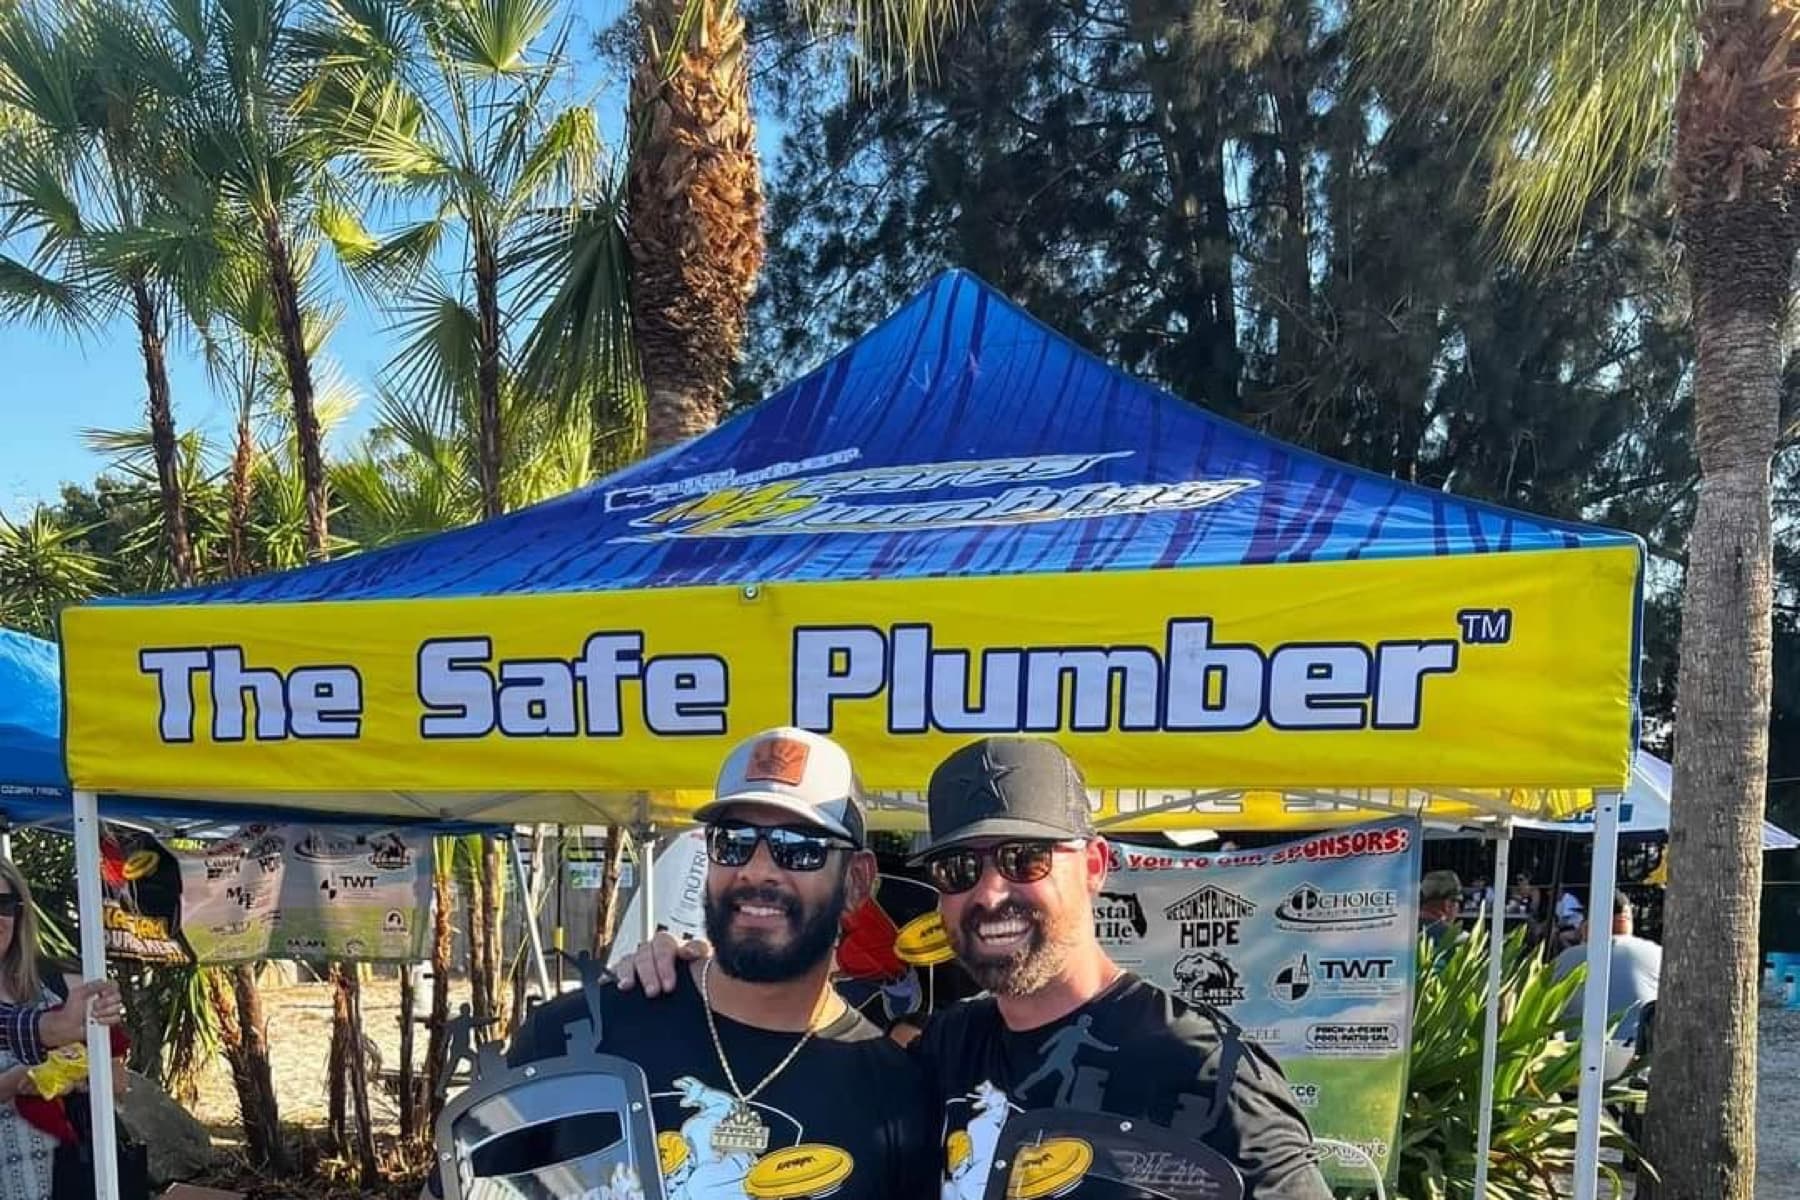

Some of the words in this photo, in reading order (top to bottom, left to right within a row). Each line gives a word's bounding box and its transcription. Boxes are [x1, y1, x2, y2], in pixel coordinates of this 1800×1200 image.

[139, 645, 362, 743] The
[416, 630, 729, 738] Safe
[792, 616, 1458, 734] Plumber
[1127, 854, 1174, 871] YOU
[1181, 857, 1210, 869] TO
[1271, 827, 1411, 864] SPONSORS:
[340, 875, 378, 888] TWT
[1319, 890, 1398, 909] CHOICE
[1093, 903, 1134, 919] stal
[1181, 921, 1241, 949] HOPE
[1319, 959, 1394, 979] TWT
